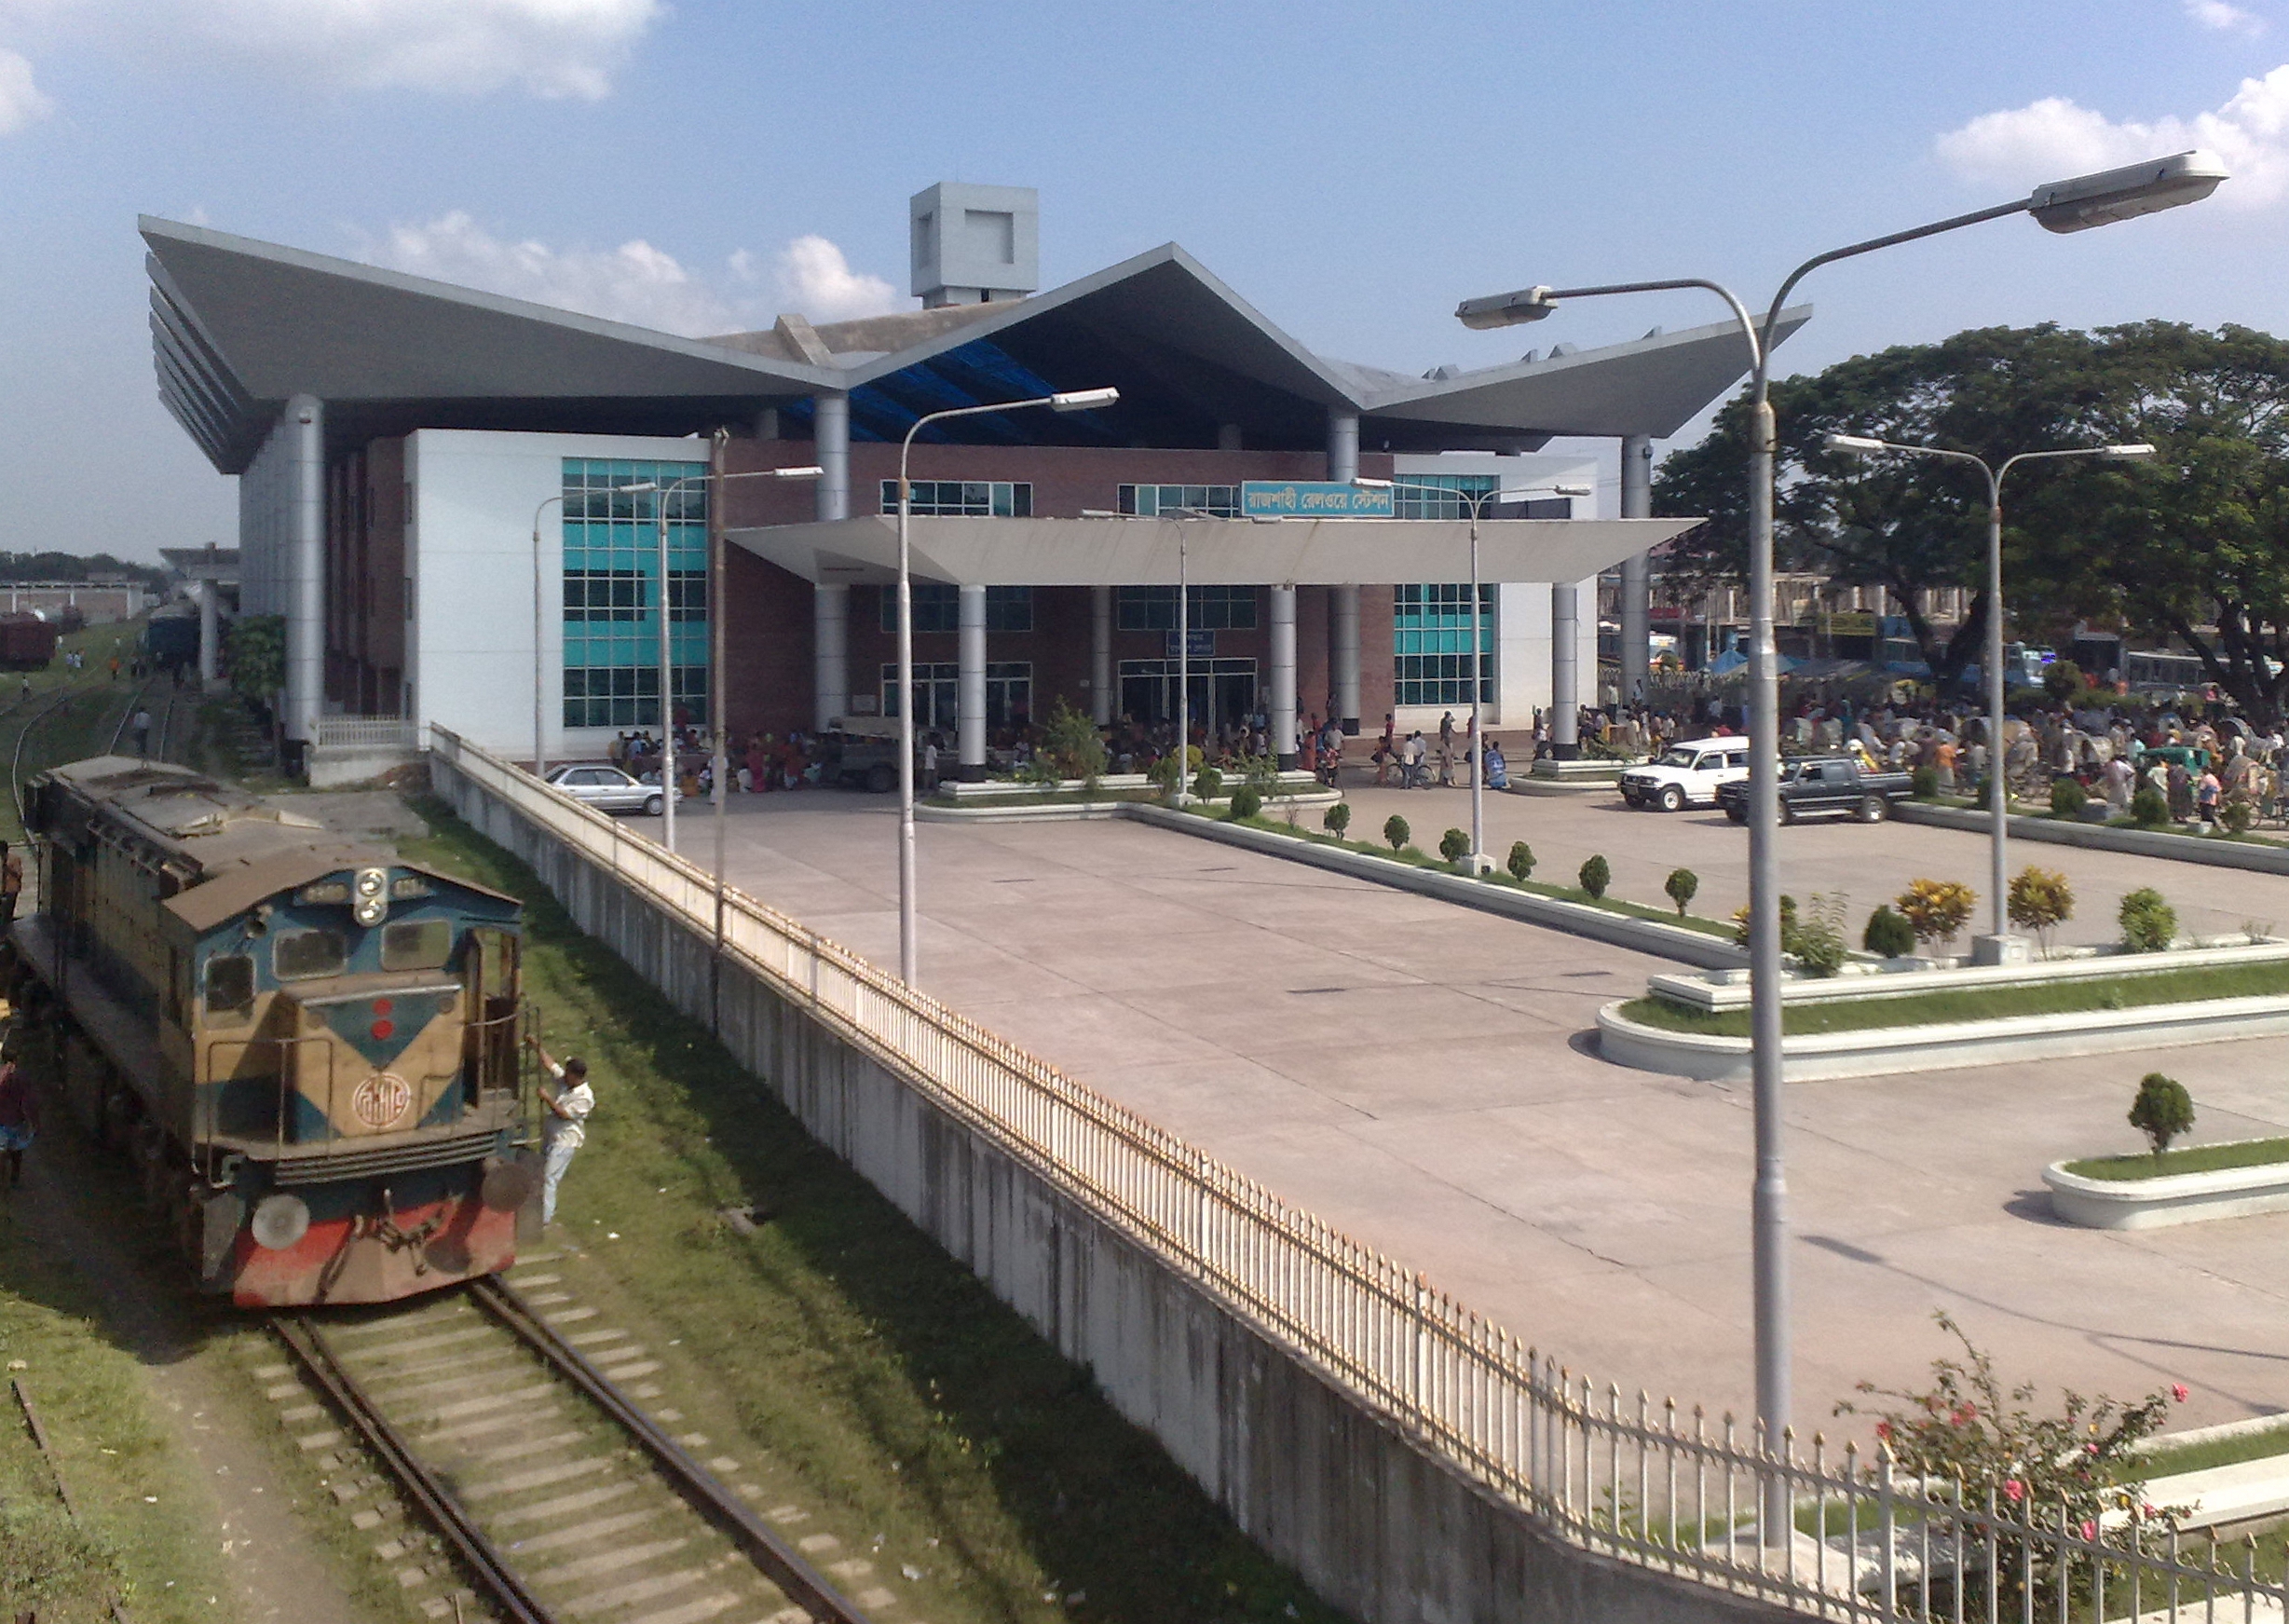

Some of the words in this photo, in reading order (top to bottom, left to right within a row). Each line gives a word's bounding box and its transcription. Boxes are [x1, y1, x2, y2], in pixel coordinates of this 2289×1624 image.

[1248, 486, 1296, 511] রাজশাহী
[1301, 492, 1348, 510] রেলওয়ে
[1353, 489, 1389, 510] স্টেশন
